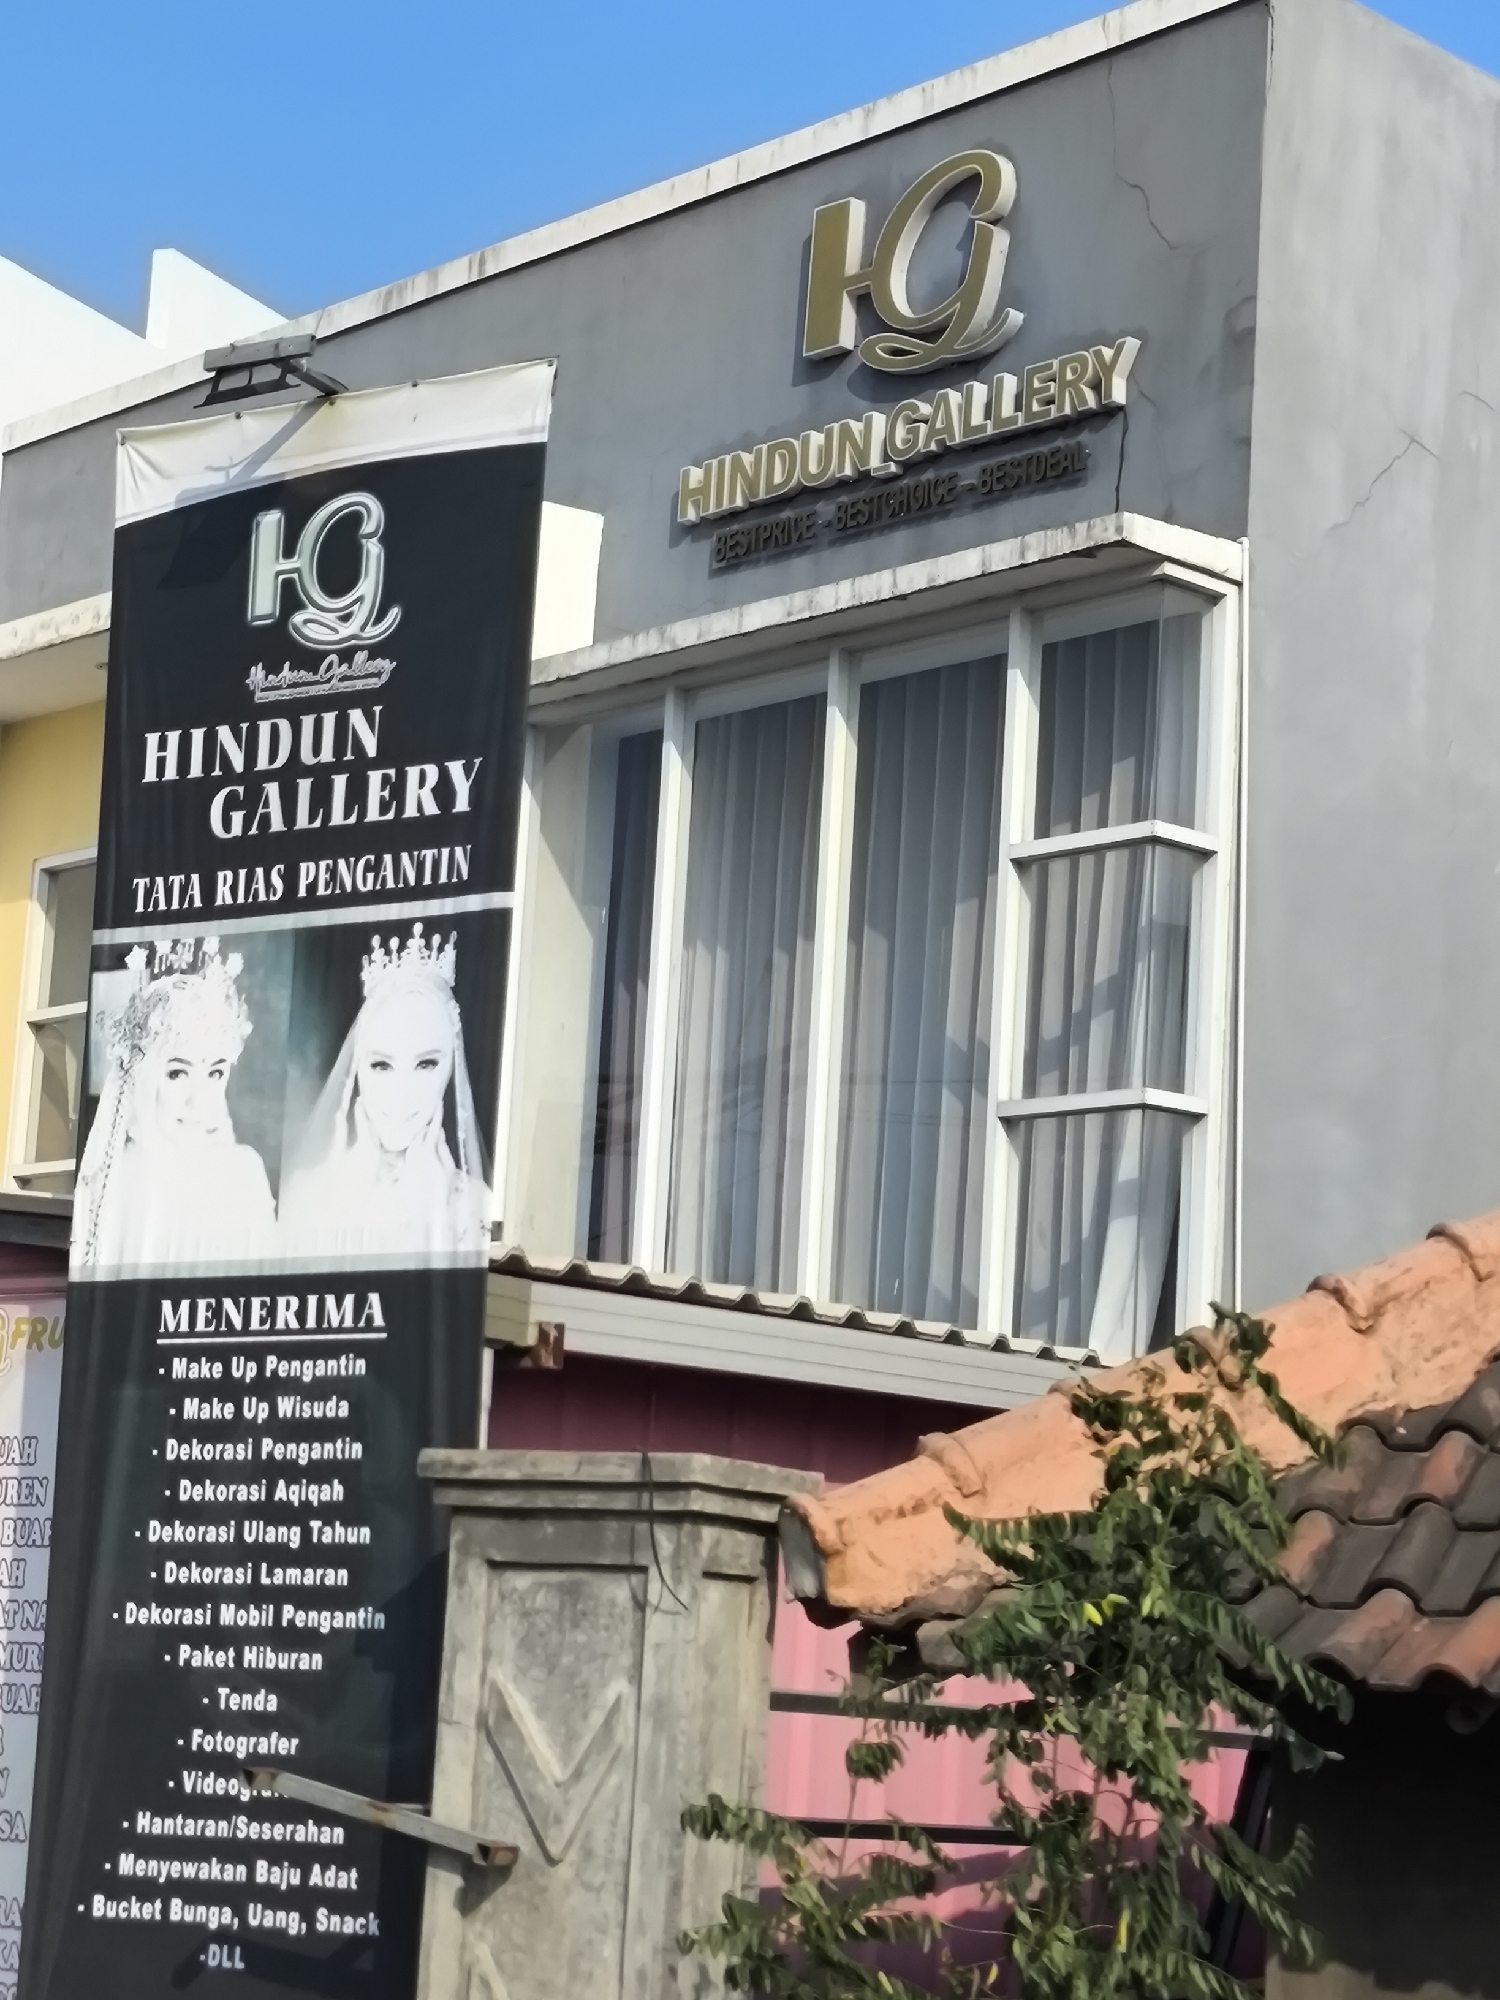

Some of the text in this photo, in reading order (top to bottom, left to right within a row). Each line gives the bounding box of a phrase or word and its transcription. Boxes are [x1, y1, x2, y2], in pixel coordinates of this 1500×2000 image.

[142, 706, 383, 784] HINDUN
[209, 757, 483, 840] GALLERY
[132, 844, 472, 913] TATA RIAS PENGANTIN
[158, 1292, 387, 1333] MENERIMA
[172, 1354, 366, 1383] Make Up Pengantin
[184, 1396, 349, 1423] Make Up Wisuda
[166, 1437, 362, 1465] Dekorasi Pengantin
[180, 1479, 344, 1507] Dekorasi Aqiqah
[148, 1520, 370, 1549] Dekorasi Ulang Tahun
[165, 1561, 348, 1585] Dekorasi Lamaran
[125, 1602, 384, 1634] Dekorasi Mobil Pengantin
[179, 1644, 322, 1670] Paket Hiburan
[218, 1688, 278, 1711] Tenda
[192, 1729, 299, 1759] Fotografer
[137, 1811, 344, 1845] Hantaran/Seserahan
[119, 1853, 358, 1890] Menyewakan Baju Adat
[93, 1894, 378, 1935] Bucket Bunga, Uang, Snack
